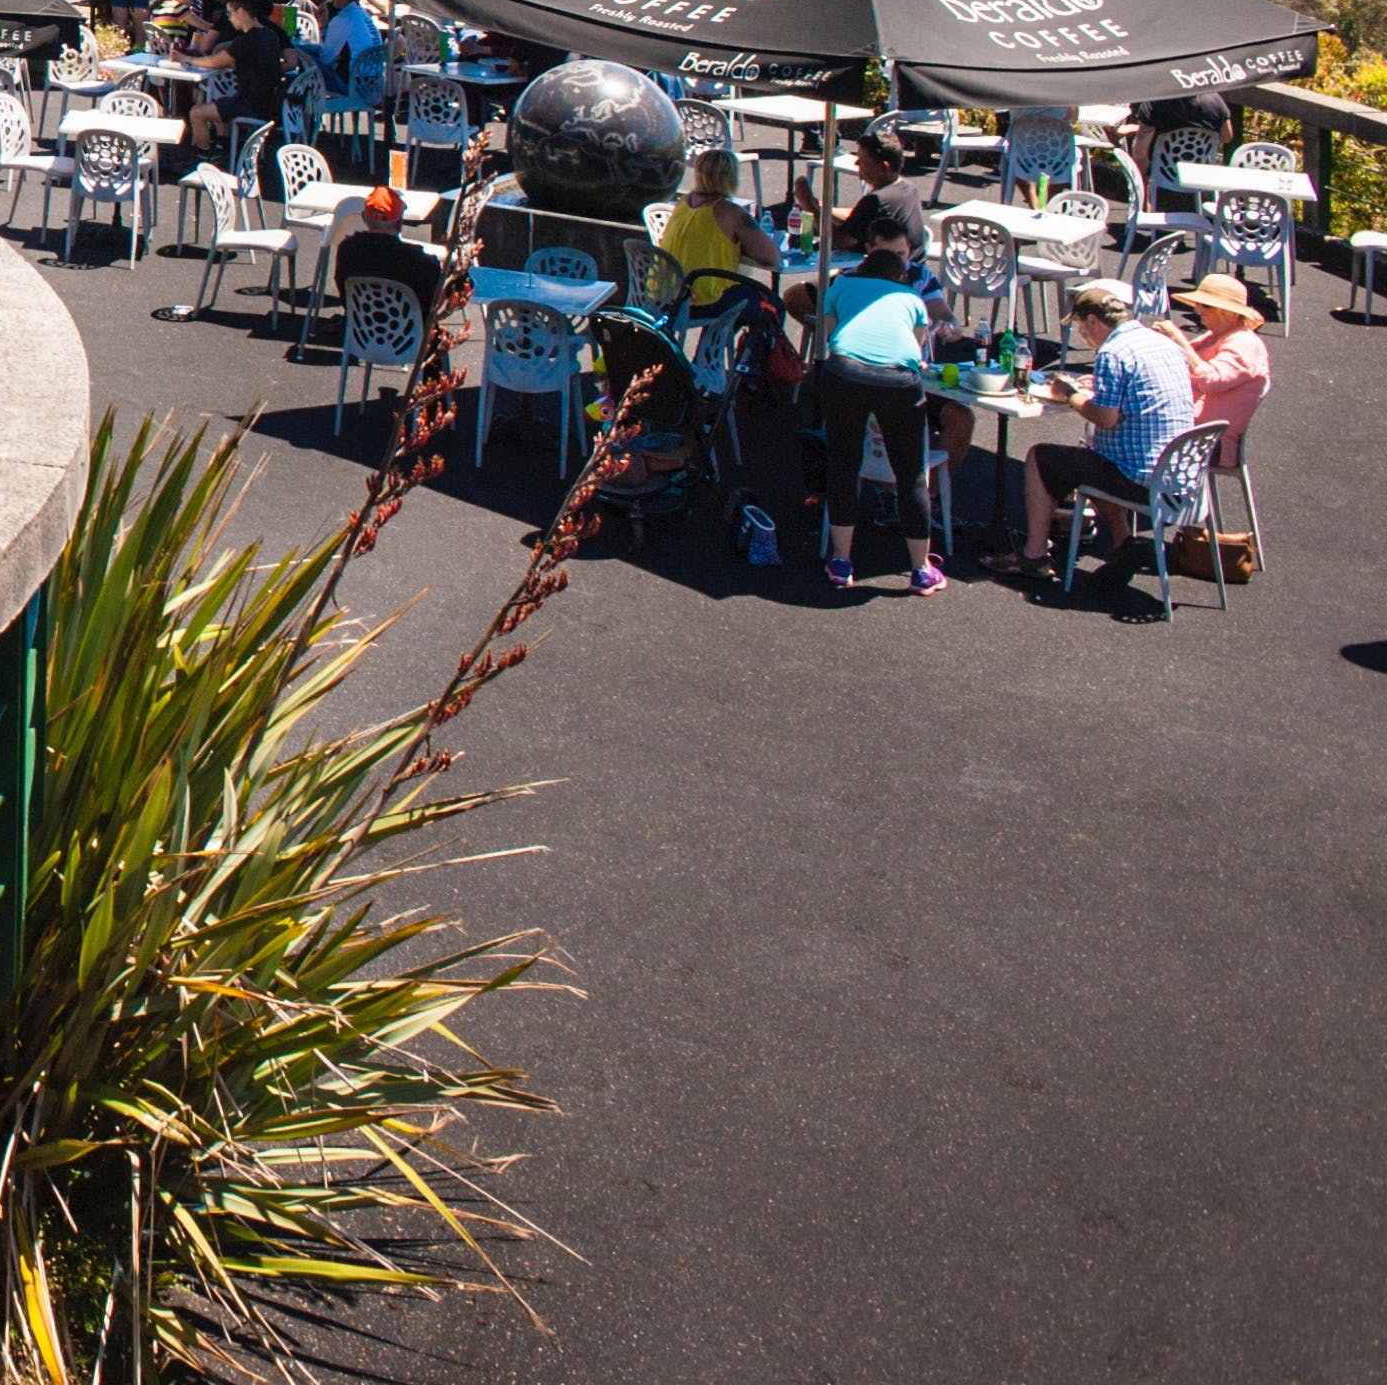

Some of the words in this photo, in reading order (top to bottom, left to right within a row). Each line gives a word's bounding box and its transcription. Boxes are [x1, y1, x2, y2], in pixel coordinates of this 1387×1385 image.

[588, 3, 637, 23] Freshly
[638, 15, 695, 33] Roasted
[988, 18, 1129, 49] COFFEE
[678, 51, 760, 81] Beraldo
[1078, 45, 1131, 61] Roasted
[1170, 55, 1247, 88] Beraldo
[1245, 49, 1304, 69] COFFEE
